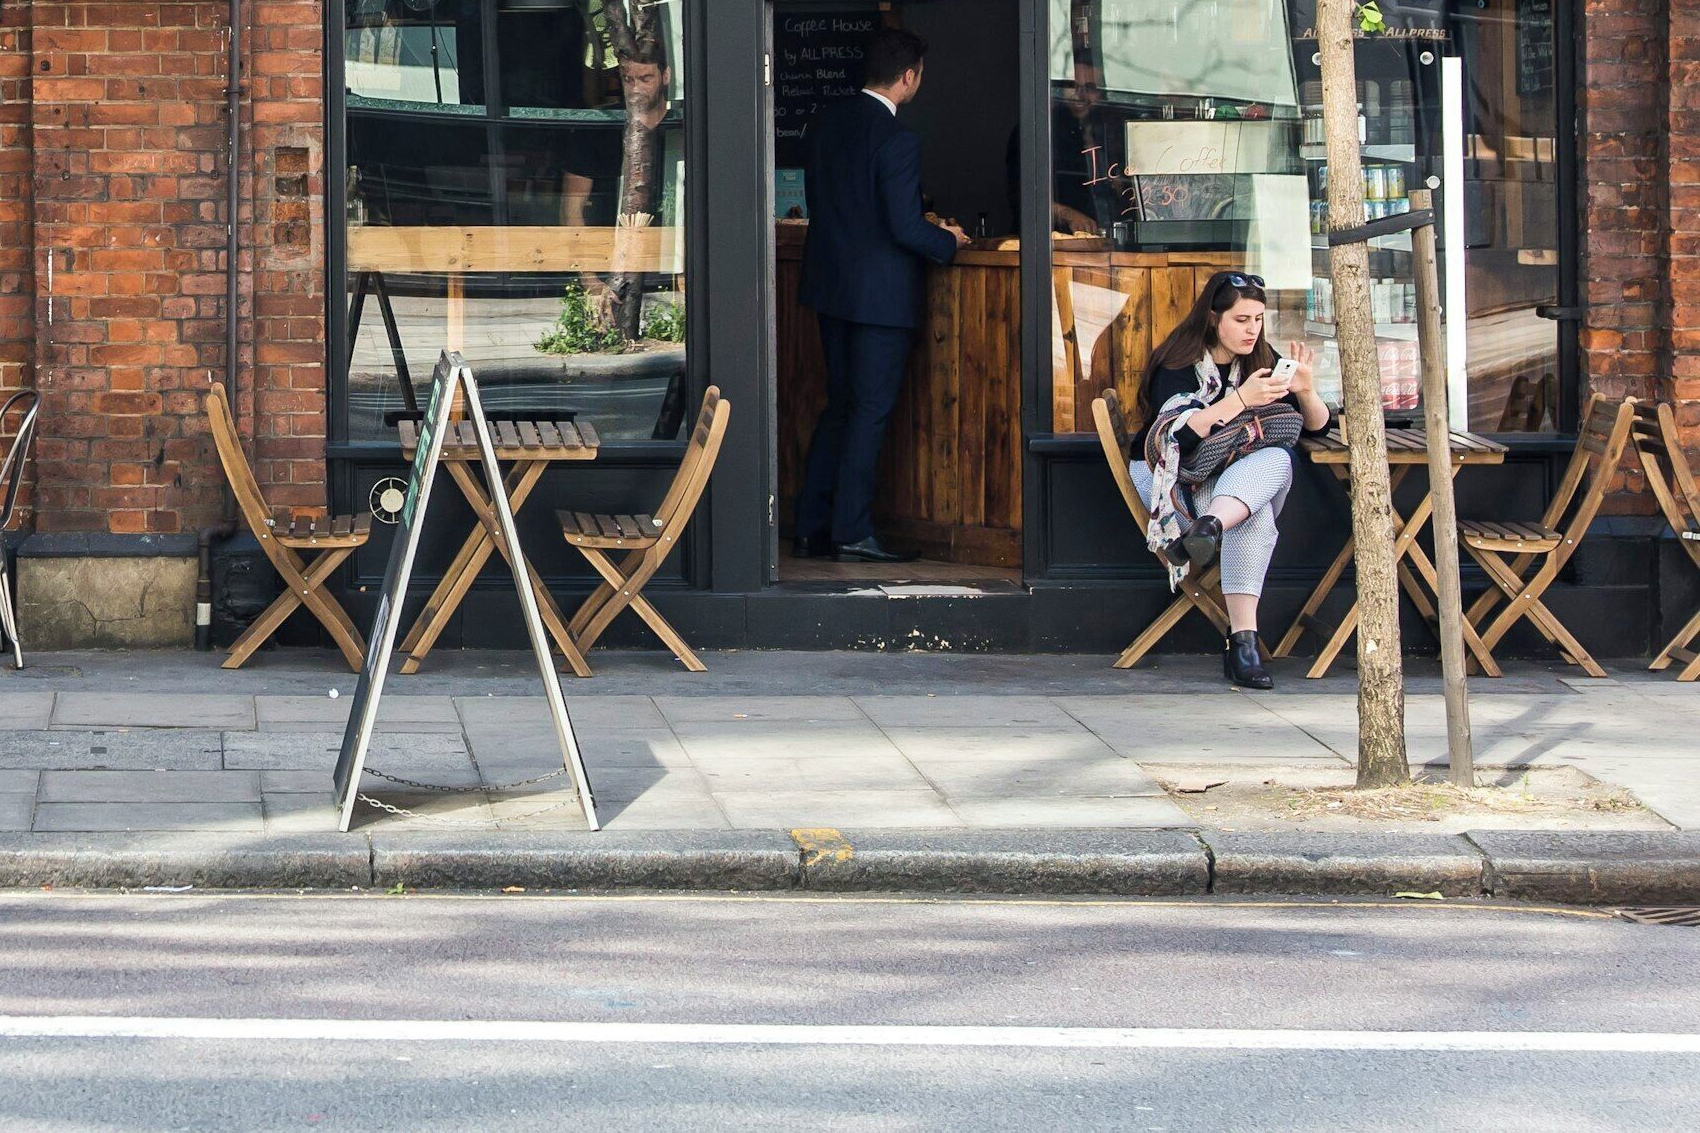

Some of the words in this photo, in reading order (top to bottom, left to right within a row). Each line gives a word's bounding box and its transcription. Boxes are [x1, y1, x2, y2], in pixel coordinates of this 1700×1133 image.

[784, 18, 828, 38] Coffee
[832, 18, 875, 33] House
[1384, 26, 1447, 39] ALLPRESS
[1080, 144, 1138, 186] Ice
[1155, 145, 1228, 175] Coffee
